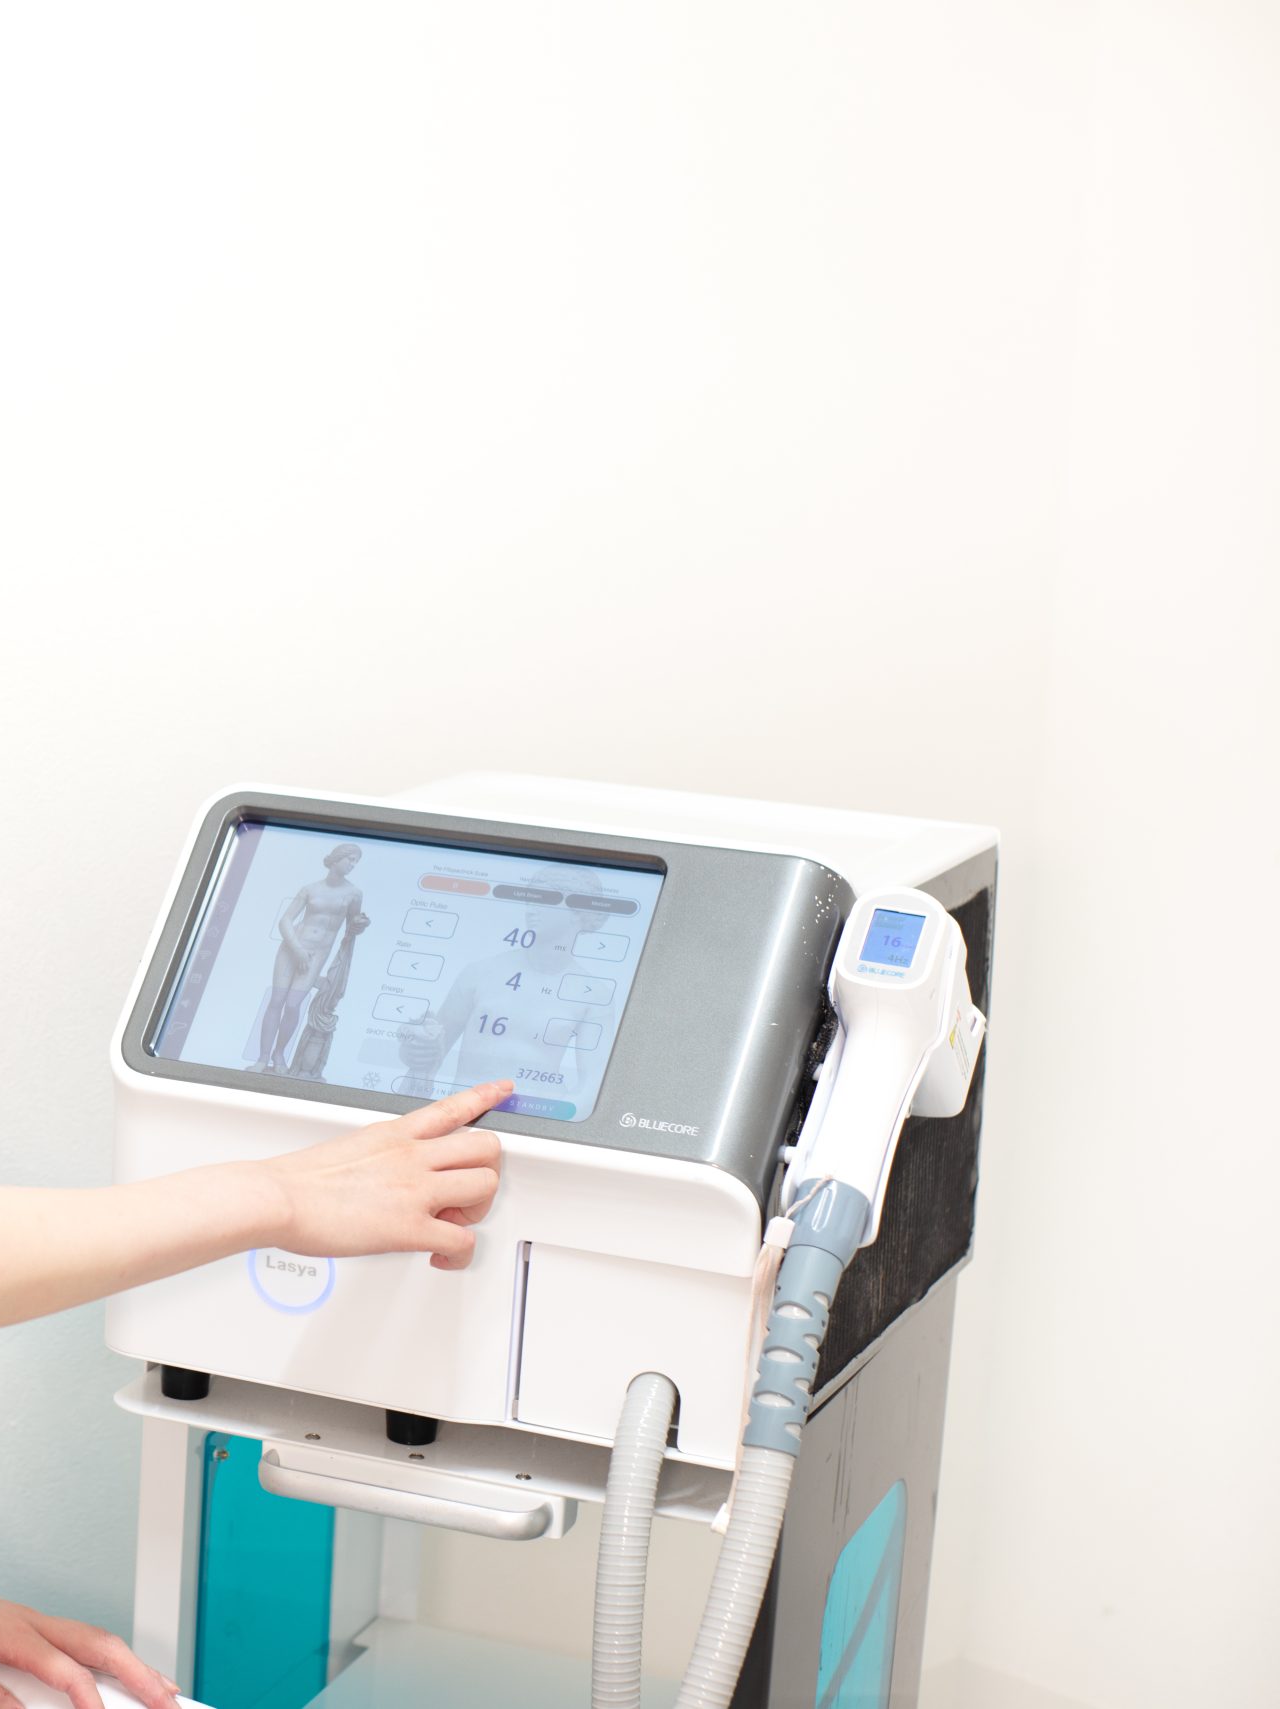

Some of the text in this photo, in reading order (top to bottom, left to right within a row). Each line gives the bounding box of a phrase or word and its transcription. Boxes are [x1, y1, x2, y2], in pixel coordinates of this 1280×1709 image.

[429, 901, 448, 909] Pulse
[503, 928, 536, 949] 40
[883, 935, 902, 948] 16
[381, 984, 404, 993] Energy
[505, 971, 552, 995] 4 Hz
[366, 1028, 385, 1036] SHOT
[479, 1014, 509, 1036] 16
[516, 1068, 564, 1084] 372663
[509, 1100, 554, 1112] STANDBY
[638, 1118, 699, 1136] BLUECORE
[266, 1255, 317, 1277] Lasya
